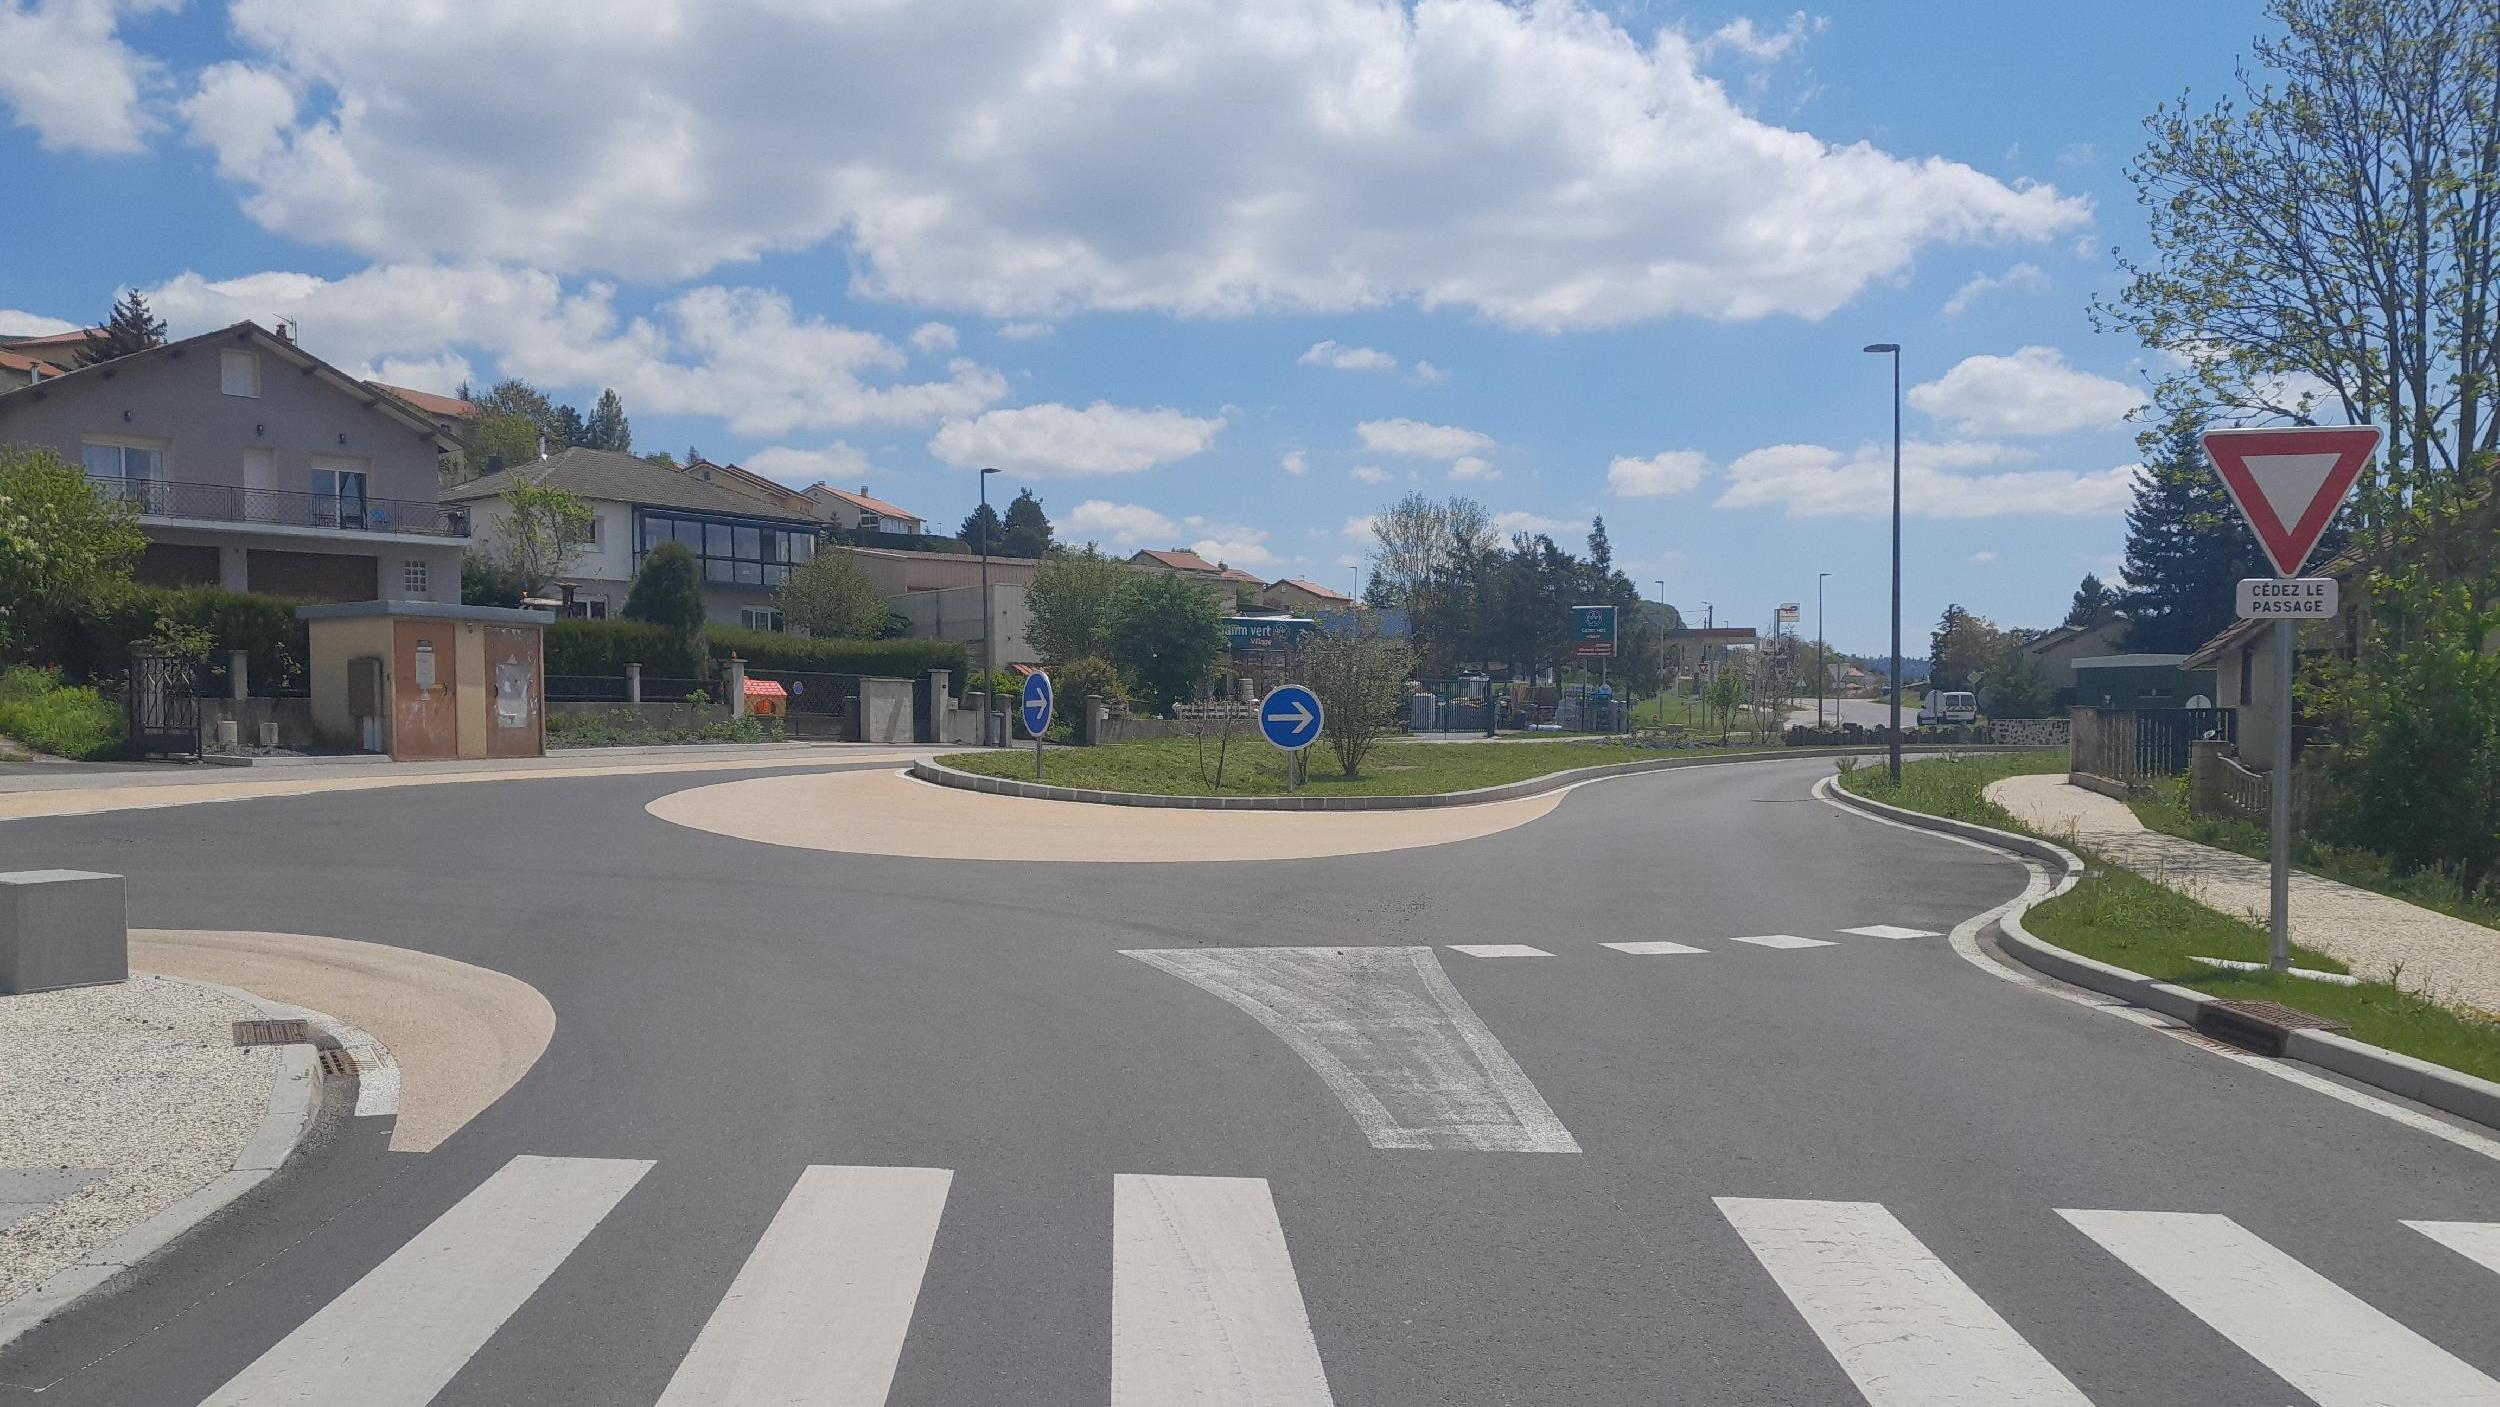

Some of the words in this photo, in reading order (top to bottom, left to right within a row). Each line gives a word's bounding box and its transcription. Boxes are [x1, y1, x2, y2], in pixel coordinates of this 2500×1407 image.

[2252, 583, 2299, 597] CÉDEZ
[2306, 585, 2324, 596] LE
[2252, 601, 2323, 612] PASSAGE
[1222, 625, 1247, 636] amm
[1250, 625, 1271, 637] vert
